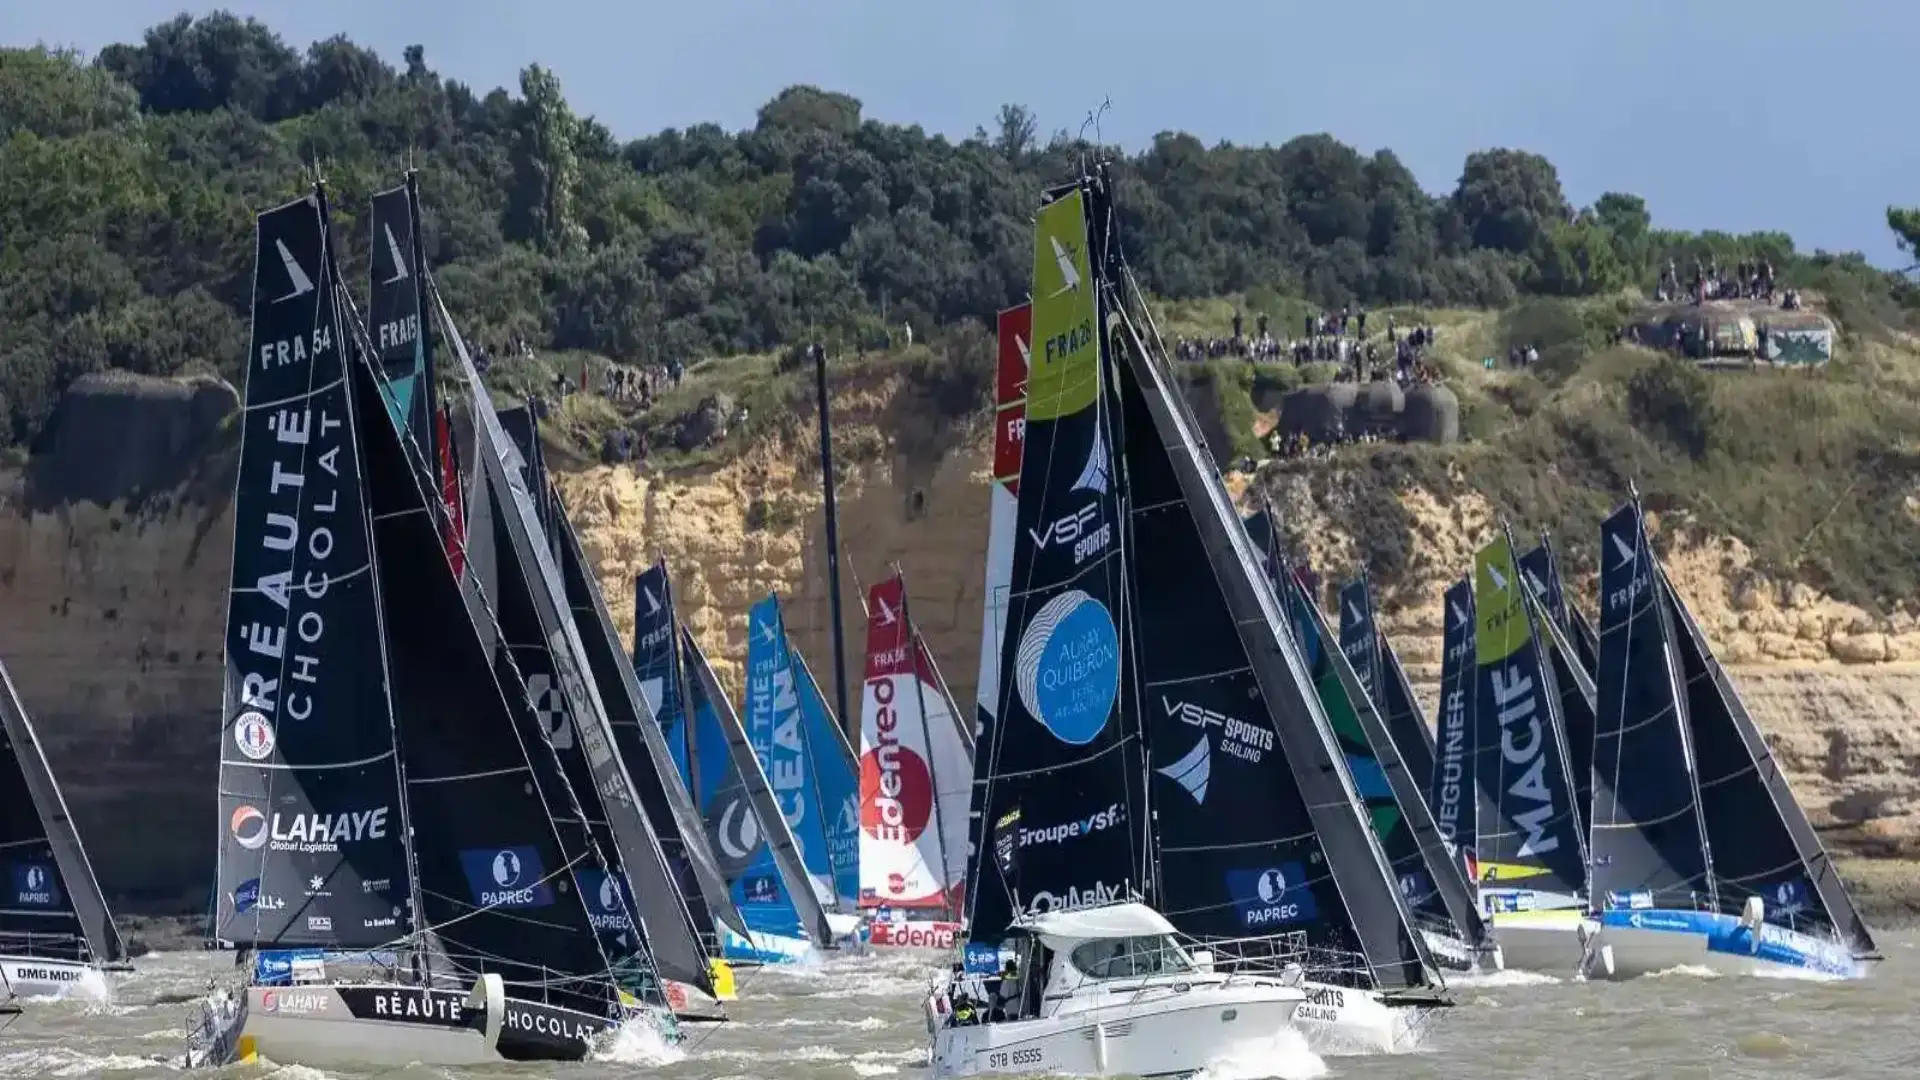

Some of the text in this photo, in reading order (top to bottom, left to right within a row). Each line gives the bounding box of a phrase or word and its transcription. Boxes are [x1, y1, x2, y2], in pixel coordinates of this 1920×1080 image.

[260, 334, 308, 370] FRA
[1029, 501, 1098, 549] VSF
[1074, 522, 1111, 564] SPORTS
[240, 409, 312, 712] RÉAUTÉ
[287, 409, 341, 721] CHOCOLAT
[753, 675, 770, 732] THE
[1162, 695, 1275, 750] VSF SPORTS
[773, 668, 805, 860] CEAN
[867, 677, 910, 845] Edenred
[1220, 739, 1262, 764] SAILING
[1491, 664, 1560, 858] MACIF
[271, 806, 389, 842] LAHAYE
[270, 840, 338, 854] Global Logistics
[481, 889, 534, 905] PAPREC
[1247, 904, 1299, 924] PAPREC
[589, 914, 630, 929] PAPREC
[885, 925, 955, 947] Edenre
[17, 968, 47, 979] DMG
[279, 994, 328, 1010] LAHAYE
[375, 991, 594, 1040] RÉAUTÉ HOCOLAT
[1298, 1006, 1336, 1021] SAILING
[989, 1048, 1042, 1068] STB 65555
